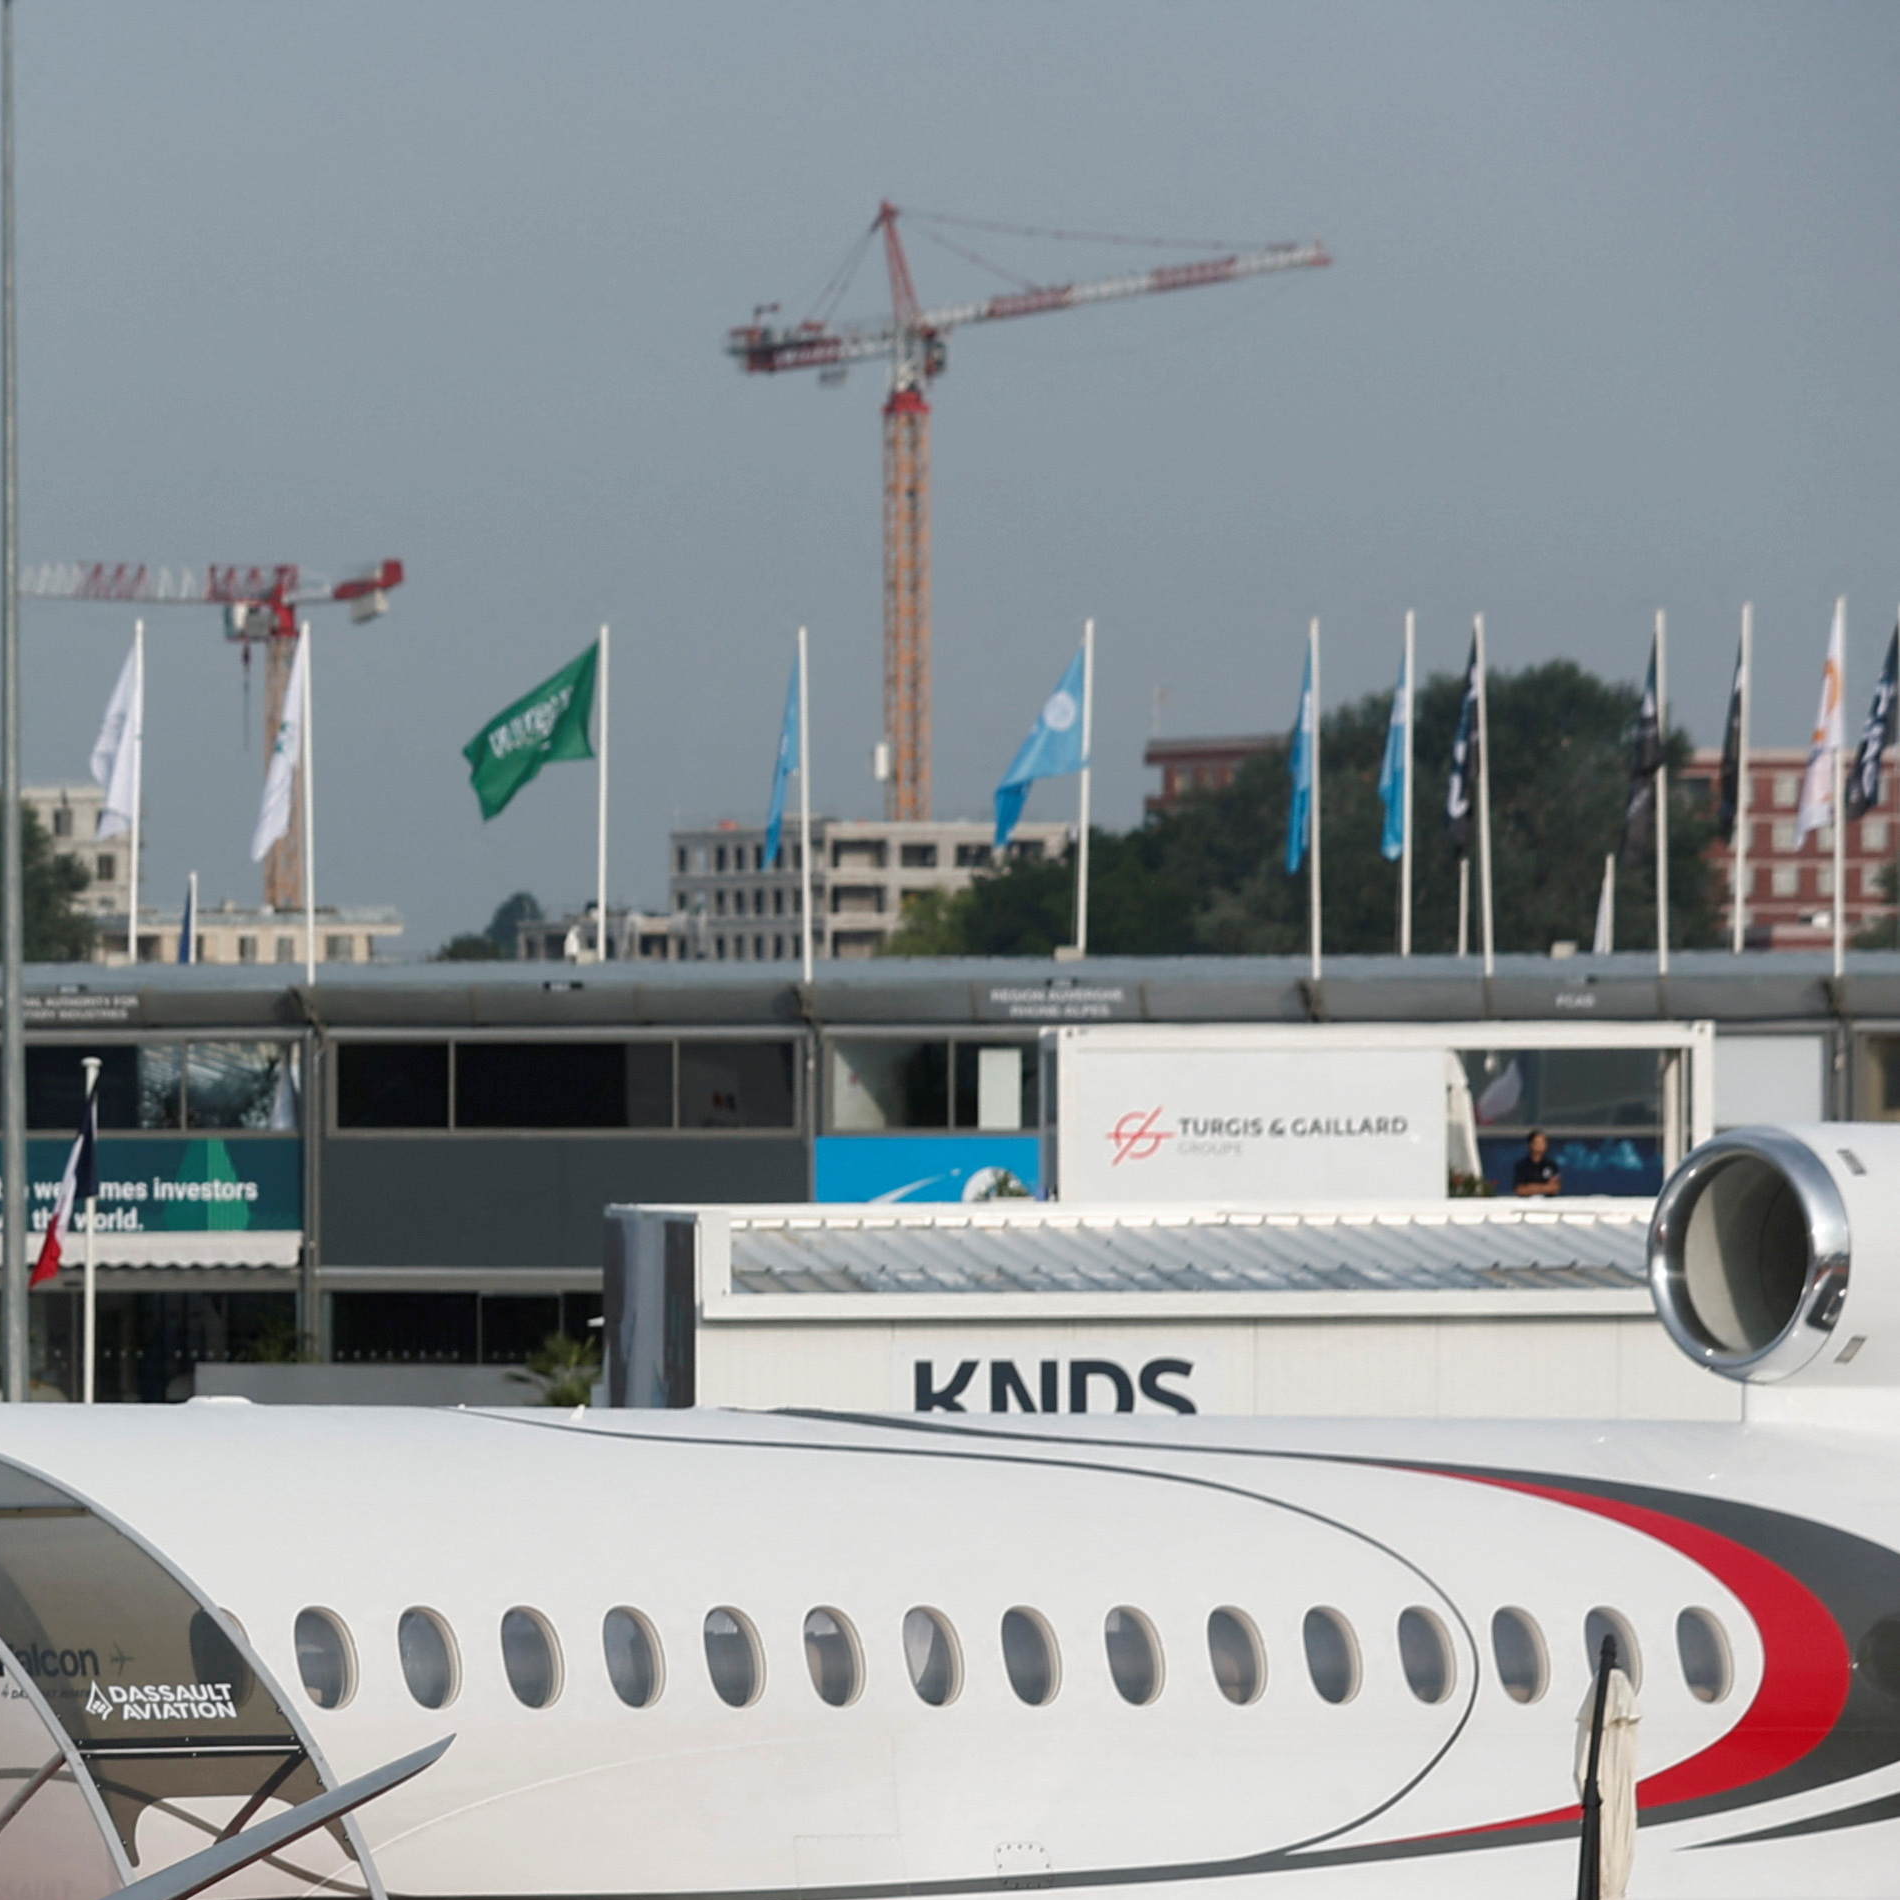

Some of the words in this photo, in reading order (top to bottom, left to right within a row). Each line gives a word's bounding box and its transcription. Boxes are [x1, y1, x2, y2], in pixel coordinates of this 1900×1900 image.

[1178, 1117, 1263, 1137] TURGIS
[1269, 1117, 1286, 1137] &
[1292, 1116, 1408, 1136] GAILLARD
[1177, 1141, 1243, 1156] GROUPE
[34, 1179, 148, 1200] wemes
[153, 1177, 258, 1201] investors
[915, 1357, 1198, 1415] KNDS
[108, 1683, 232, 1703] DASSAULT
[123, 1702, 238, 1721] AVIATION
